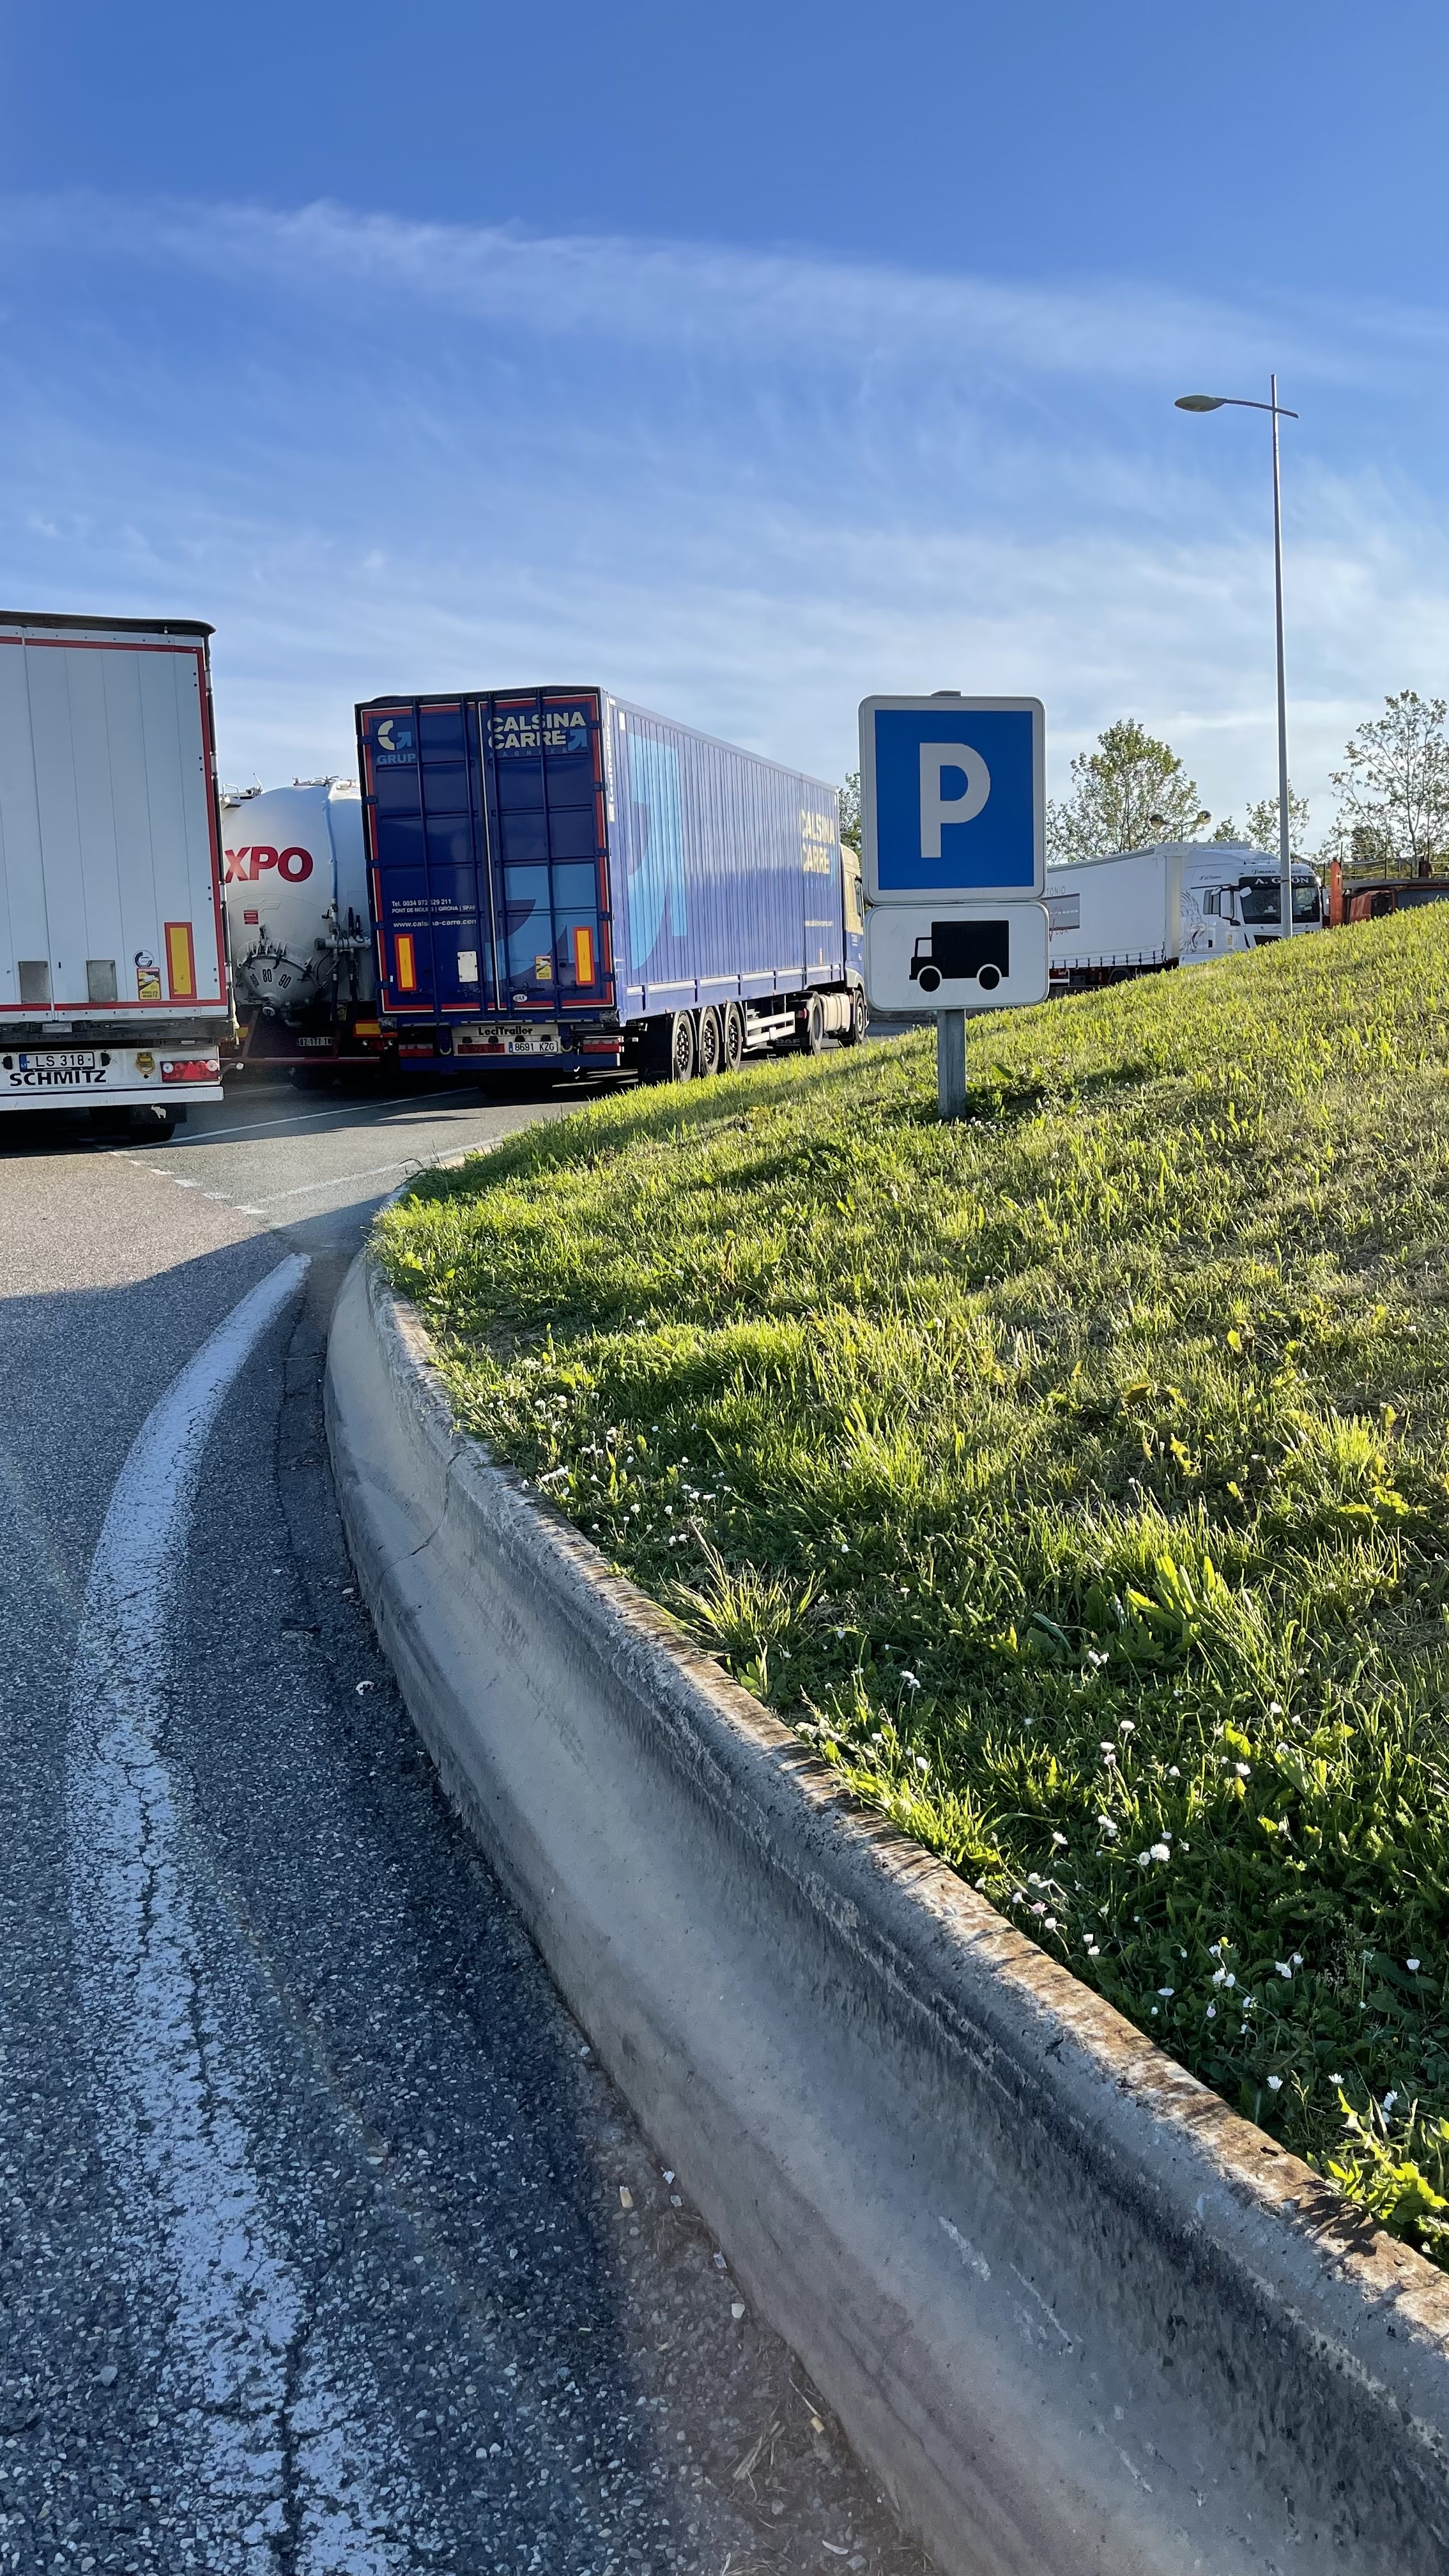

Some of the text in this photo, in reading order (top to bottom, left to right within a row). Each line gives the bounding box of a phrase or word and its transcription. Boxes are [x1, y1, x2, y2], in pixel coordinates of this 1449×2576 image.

[487, 711, 586, 733] CALSINA
[377, 753, 416, 765] GRUP
[919, 742, 990, 858] P
[799, 809, 835, 845] CALSINA
[224, 847, 313, 883] XPO
[1271, 876, 1309, 884] GÓN
[1045, 885, 1066, 896] TONIO
[262, 969, 273, 983] 80
[278, 974, 292, 989] 90
[478, 1025, 533, 1036] LeciTrailer
[514, 1043, 534, 1051] 8691
[539, 1042, 555, 1051] KZG
[36, 1055, 55, 1067] LS
[59, 1054, 85, 1066] 318
[10, 1070, 107, 1087] SCHMITZ
